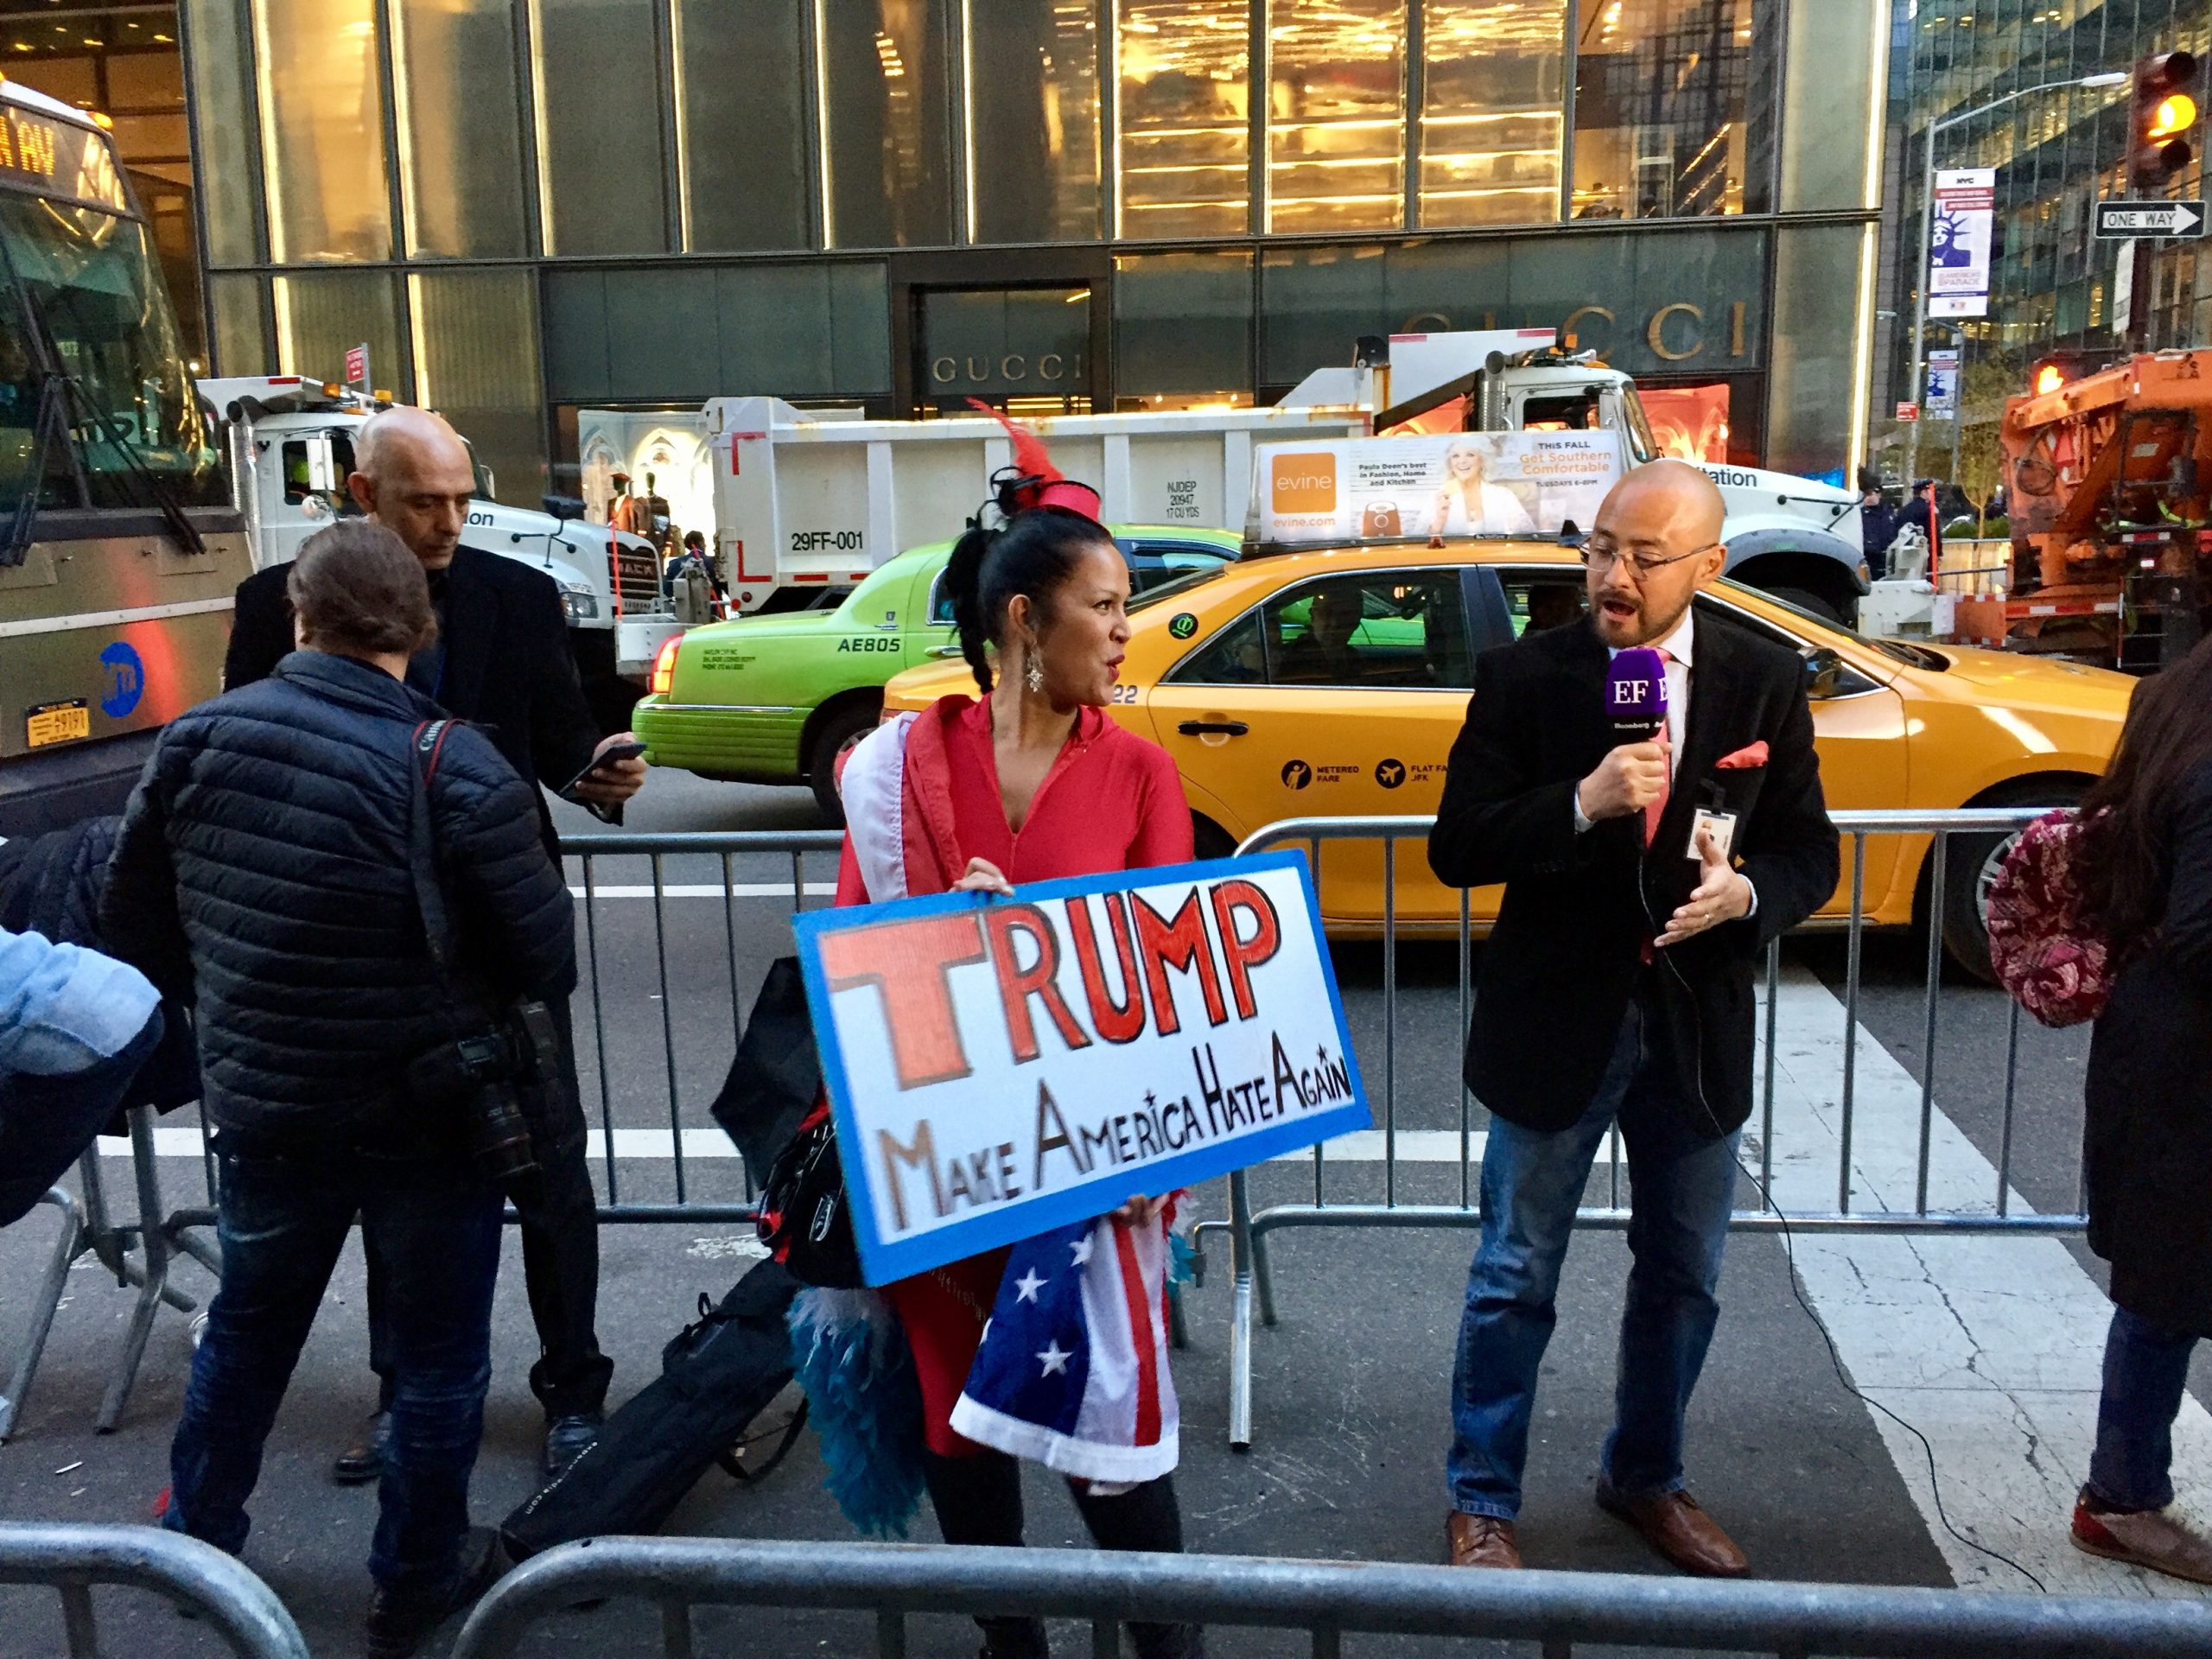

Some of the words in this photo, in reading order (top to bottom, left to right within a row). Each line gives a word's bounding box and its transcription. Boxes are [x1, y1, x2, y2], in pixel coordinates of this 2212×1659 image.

[2107, 212, 2137, 226] ONE
[2145, 213, 2177, 226] WAY
[1402, 302, 1746, 361] CCI
[932, 353, 1082, 383] GUCCI
[1520, 454, 1544, 464] Get
[1548, 451, 1611, 462] Southern
[1522, 461, 1610, 475] Comfortable
[1276, 473, 1332, 491] evine
[1696, 467, 1758, 487] ation
[1167, 481, 1197, 493] NJDEP
[1170, 494, 1195, 505] 20947
[1185, 506, 1200, 518] YDS
[1274, 517, 1336, 528] evine.com
[791, 531, 863, 551] 29FF-001
[837, 639, 900, 652] AE805
[1613, 680, 1649, 704] EF
[1317, 766, 1360, 774] METERED
[1411, 765, 1434, 773] FLAT
[1317, 774, 1340, 783] FARE
[817, 879, 1281, 1091] TRUMP
[1192, 1042, 1274, 1138] HATE
